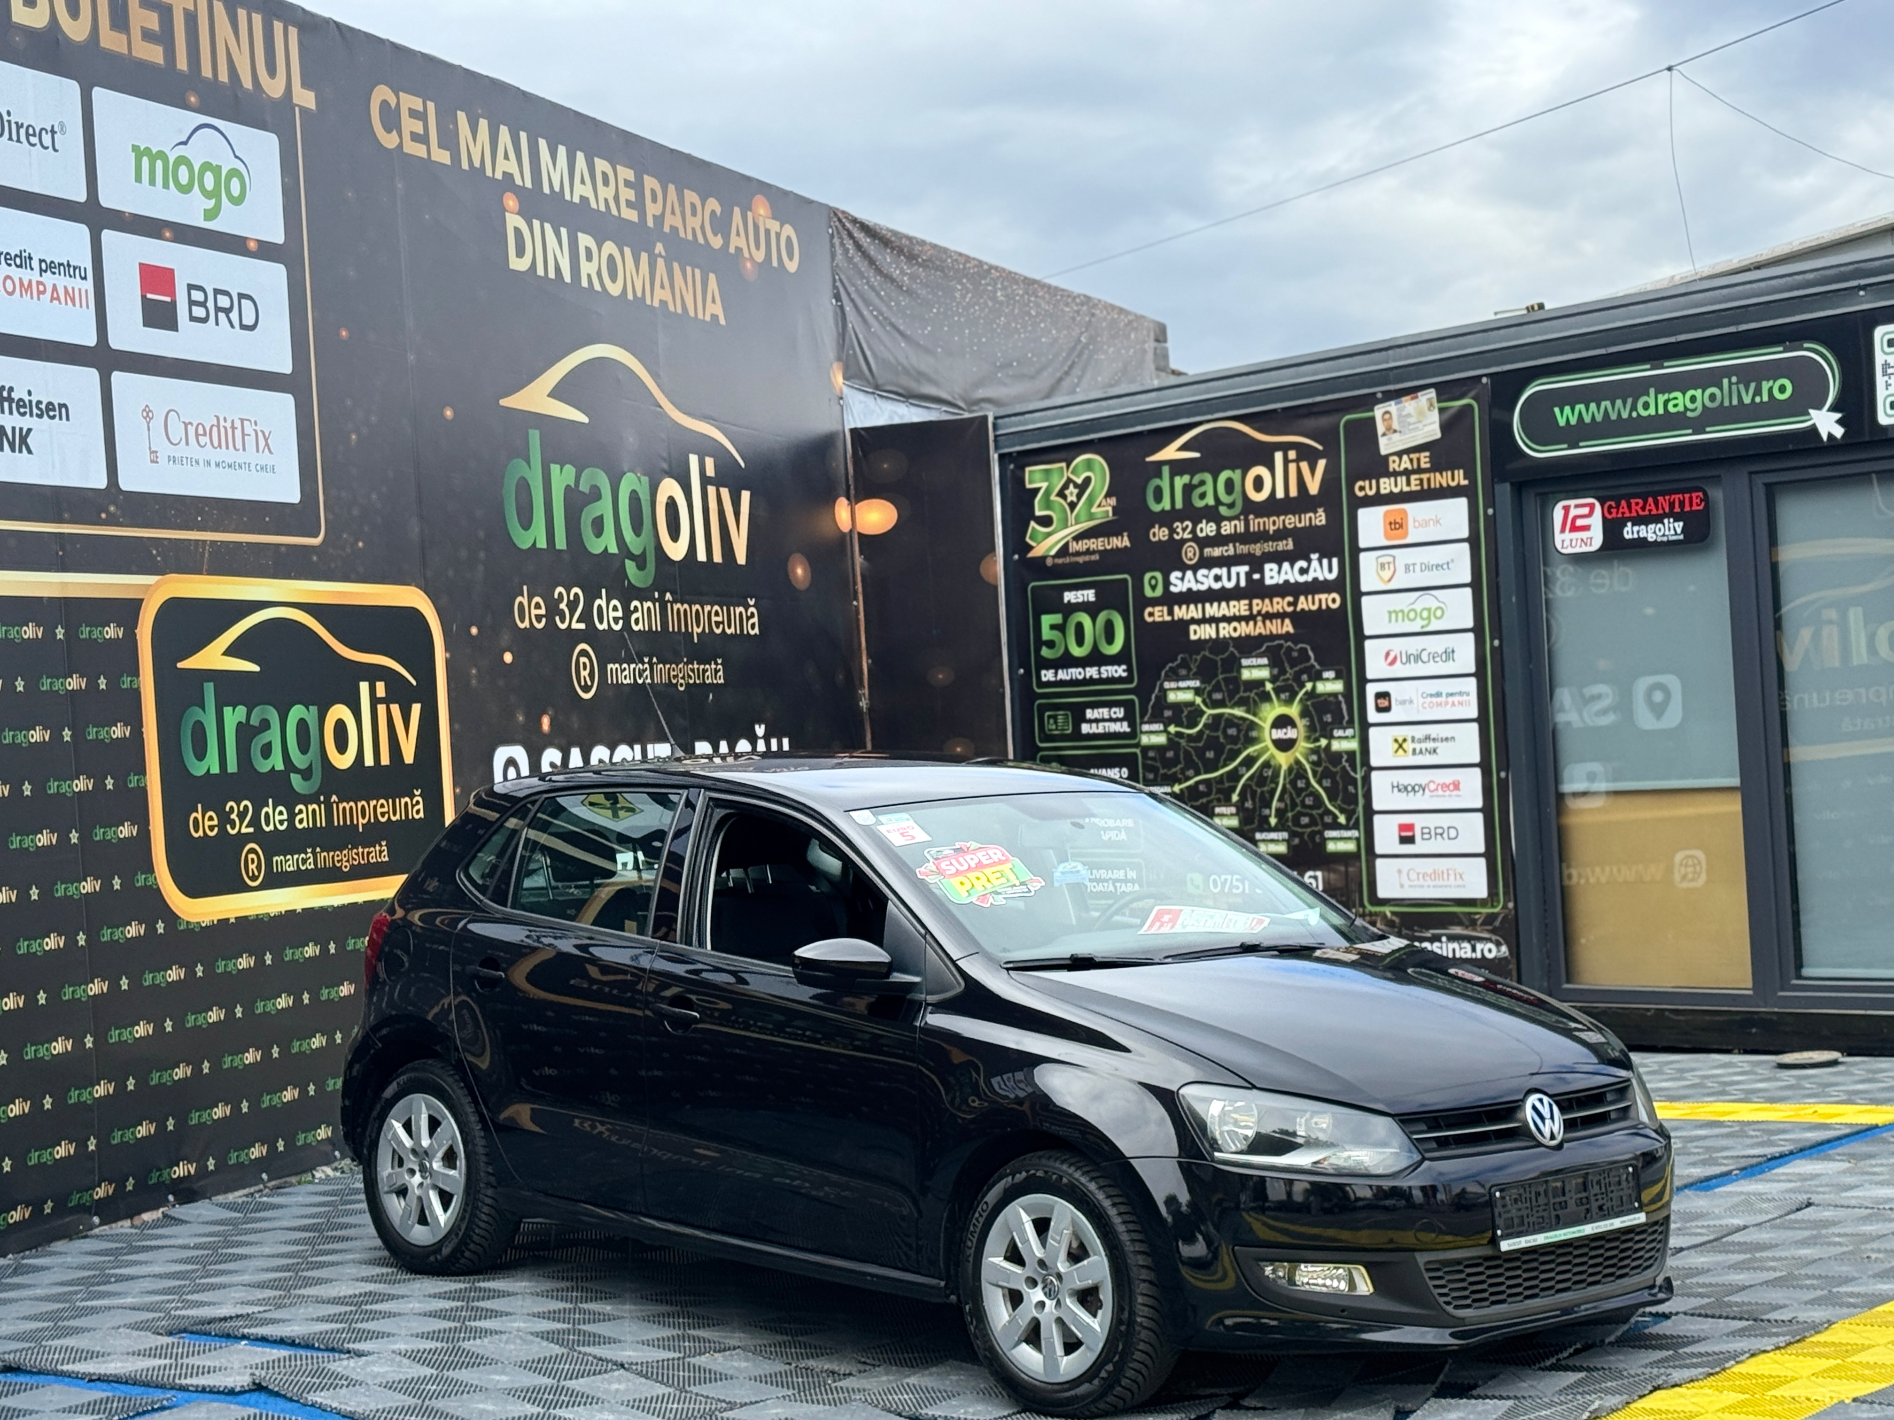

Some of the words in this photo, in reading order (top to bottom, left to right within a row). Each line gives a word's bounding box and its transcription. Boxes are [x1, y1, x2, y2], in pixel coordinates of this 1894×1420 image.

[131, 143, 247, 221] mogo
[369, 84, 452, 166] CEL
[456, 109, 533, 190] MAI
[537, 136, 640, 223] MARE
[642, 173, 724, 249] PARC
[728, 205, 800, 274] AUTO
[39, 258, 88, 281] pentru
[504, 211, 571, 284] DIN
[577, 241, 727, 326] ROMÂNIA
[0, 274, 90, 309] OMPANII
[186, 282, 260, 332] BRD
[1552, 375, 1794, 427] www.dragoliv.ro
[163, 408, 274, 455] CreditFix
[167, 455, 200, 468] PRIETEN
[203, 458, 212, 469] IN
[214, 460, 253, 472] MOMENTE
[255, 463, 276, 475] CHEIE
[1388, 451, 1431, 472] RATE
[1145, 449, 1327, 517] dragoliv
[1354, 479, 1377, 497] CU
[1379, 469, 1469, 495] BULETINUL
[502, 428, 751, 588] dragoliv
[1024, 452, 1111, 548] 32
[1101, 496, 1117, 508] ANI
[1603, 491, 1706, 519] GARANTIE
[1149, 523, 1169, 542] de
[1172, 521, 1193, 540] 32
[1196, 518, 1217, 538] de
[1220, 515, 1245, 535] ani
[1249, 507, 1326, 535] împreună
[1388, 516, 1404, 532] tbi
[1412, 515, 1442, 530] bank
[1559, 502, 1596, 534] 12
[1622, 517, 1685, 543] dragoliv
[1069, 532, 1131, 554] ÎMPREUNĂ
[1203, 542, 1234, 558] marcă
[1235, 537, 1294, 557] înregistrată
[1560, 536, 1594, 551] LUNI
[1169, 565, 1250, 593] SASCUT
[1263, 553, 1340, 586] BACĂU
[1380, 561, 1392, 572] BT
[1404, 562, 1418, 574] BT
[1063, 589, 1096, 604] PESTE
[1144, 605, 1172, 623] CEL
[1173, 602, 1204, 620] MAI
[1205, 599, 1250, 619] MARE
[1251, 596, 1294, 615] PARC
[1296, 592, 1341, 611] AUTO
[513, 585, 547, 630] de
[554, 586, 586, 631] 32
[592, 588, 624, 631] de
[629, 591, 661, 632] ani
[664, 592, 760, 644] împreună
[1387, 604, 1446, 630] mogo
[78, 622, 124, 643] dragoliv
[1040, 609, 1125, 660] 500
[1189, 623, 1217, 641] DIN
[1218, 616, 1295, 638] ROMÂNIA
[1399, 647, 1456, 665] UniCredit
[39, 674, 87, 694] dragoliv
[607, 656, 651, 685] marcă
[652, 656, 725, 691] înregistrată
[1040, 669, 1056, 682] DE
[1056, 667, 1084, 681] AUTO
[1084, 666, 1099, 680] PE
[1100, 665, 1128, 679] STOC
[1394, 696, 1414, 708] bank
[1420, 690, 1441, 700] Credit
[1442, 689, 1470, 699] pentru
[1420, 700, 1471, 710] COMPANII
[1085, 708, 1110, 720] RATE
[1110, 707, 1124, 719] CU
[0, 725, 51, 747] dragoliv
[85, 722, 131, 743] dragoliv
[180, 681, 422, 795] dragoliv
[1080, 721, 1131, 735] BULETINUL
[1271, 726, 1299, 740] BACĂU
[1410, 735, 1456, 746] Raiffeisen
[1411, 747, 1439, 757] BANK
[46, 774, 94, 797] dragoliv
[1390, 780, 1461, 797] HappyCredit
[189, 803, 219, 838] de
[225, 799, 255, 836] 32
[260, 798, 289, 833] de
[294, 796, 326, 831] ani
[330, 788, 425, 833] împreună
[8, 828, 58, 851] dragoliv
[92, 821, 138, 842] dragoliv
[899, 831, 917, 842] 5
[1419, 826, 1460, 842] BRD
[272, 846, 316, 873] marcă
[316, 840, 390, 873] înregistrată
[940, 848, 1007, 875] SUPER
[1126, 867, 1137, 880] ÎN
[1406, 868, 1465, 884] CreditFix
[53, 877, 101, 899] dragoliv
[16, 932, 66, 956] dragoliv
[100, 920, 146, 944] dragoliv
[61, 978, 109, 1002] dragoliv
[142, 965, 186, 987] dragoliv
[215, 953, 255, 975] dragoliv
[283, 941, 321, 963] dragoliv
[23, 1036, 73, 1061] dragoliv
[107, 1020, 154, 1043] dragoliv
[185, 1006, 226, 1029] dragoliv
[254, 992, 294, 1014] dragoliv
[319, 980, 355, 1002] dragoliv
[66, 1080, 116, 1104] dragoliv
[148, 1063, 193, 1087] dragoliv
[221, 1047, 262, 1070] dragoliv
[290, 1032, 328, 1054] dragoliv
[26, 1140, 76, 1166] dragoliv
[109, 1120, 157, 1145] dragoliv
[188, 1102, 231, 1126] dragoliv
[260, 1085, 300, 1109] dragoliv
[68, 1181, 116, 1208] dragoliv
[148, 1161, 197, 1186] dragoliv
[227, 1141, 268, 1166] dragoliv
[295, 1124, 333, 1147] dragoliv
